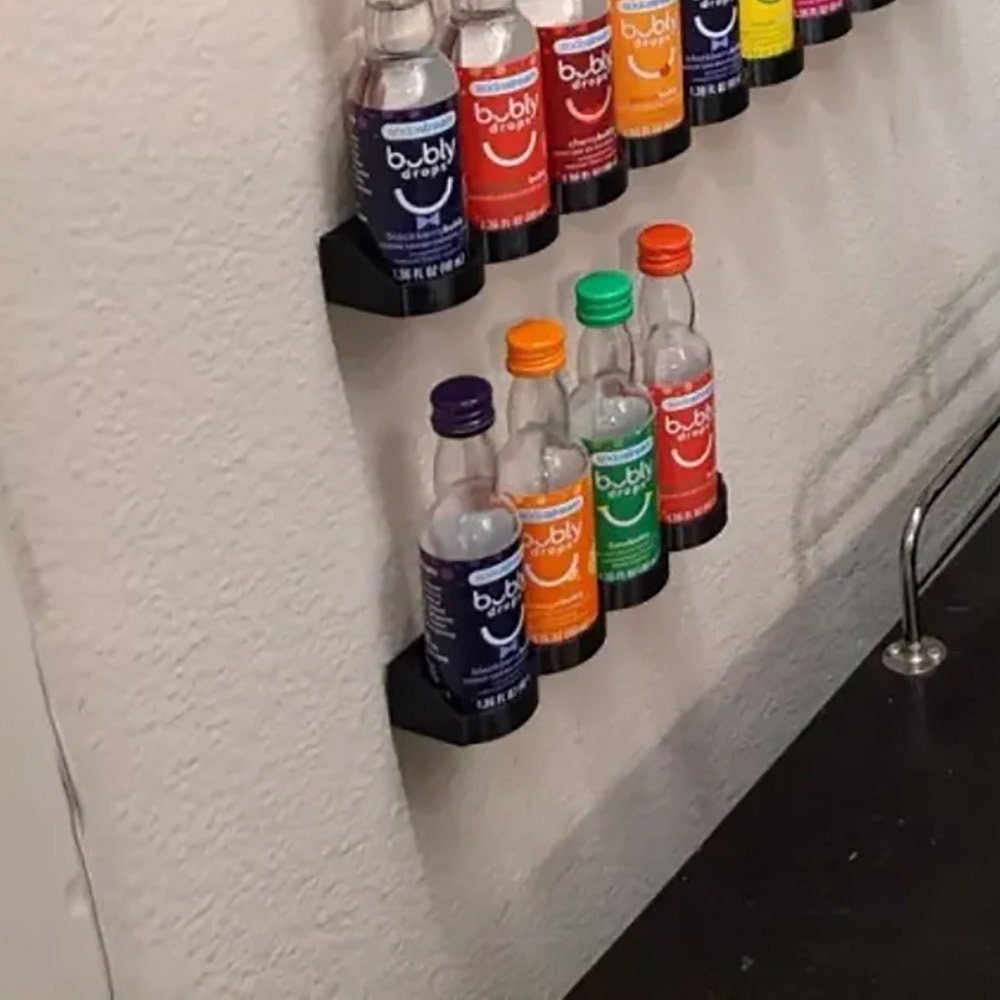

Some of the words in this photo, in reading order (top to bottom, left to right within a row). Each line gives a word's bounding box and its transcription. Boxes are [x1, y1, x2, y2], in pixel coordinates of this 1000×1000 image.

[473, 92, 539, 125] bubly
[386, 136, 457, 170] bubly
[400, 161, 449, 181] drops
